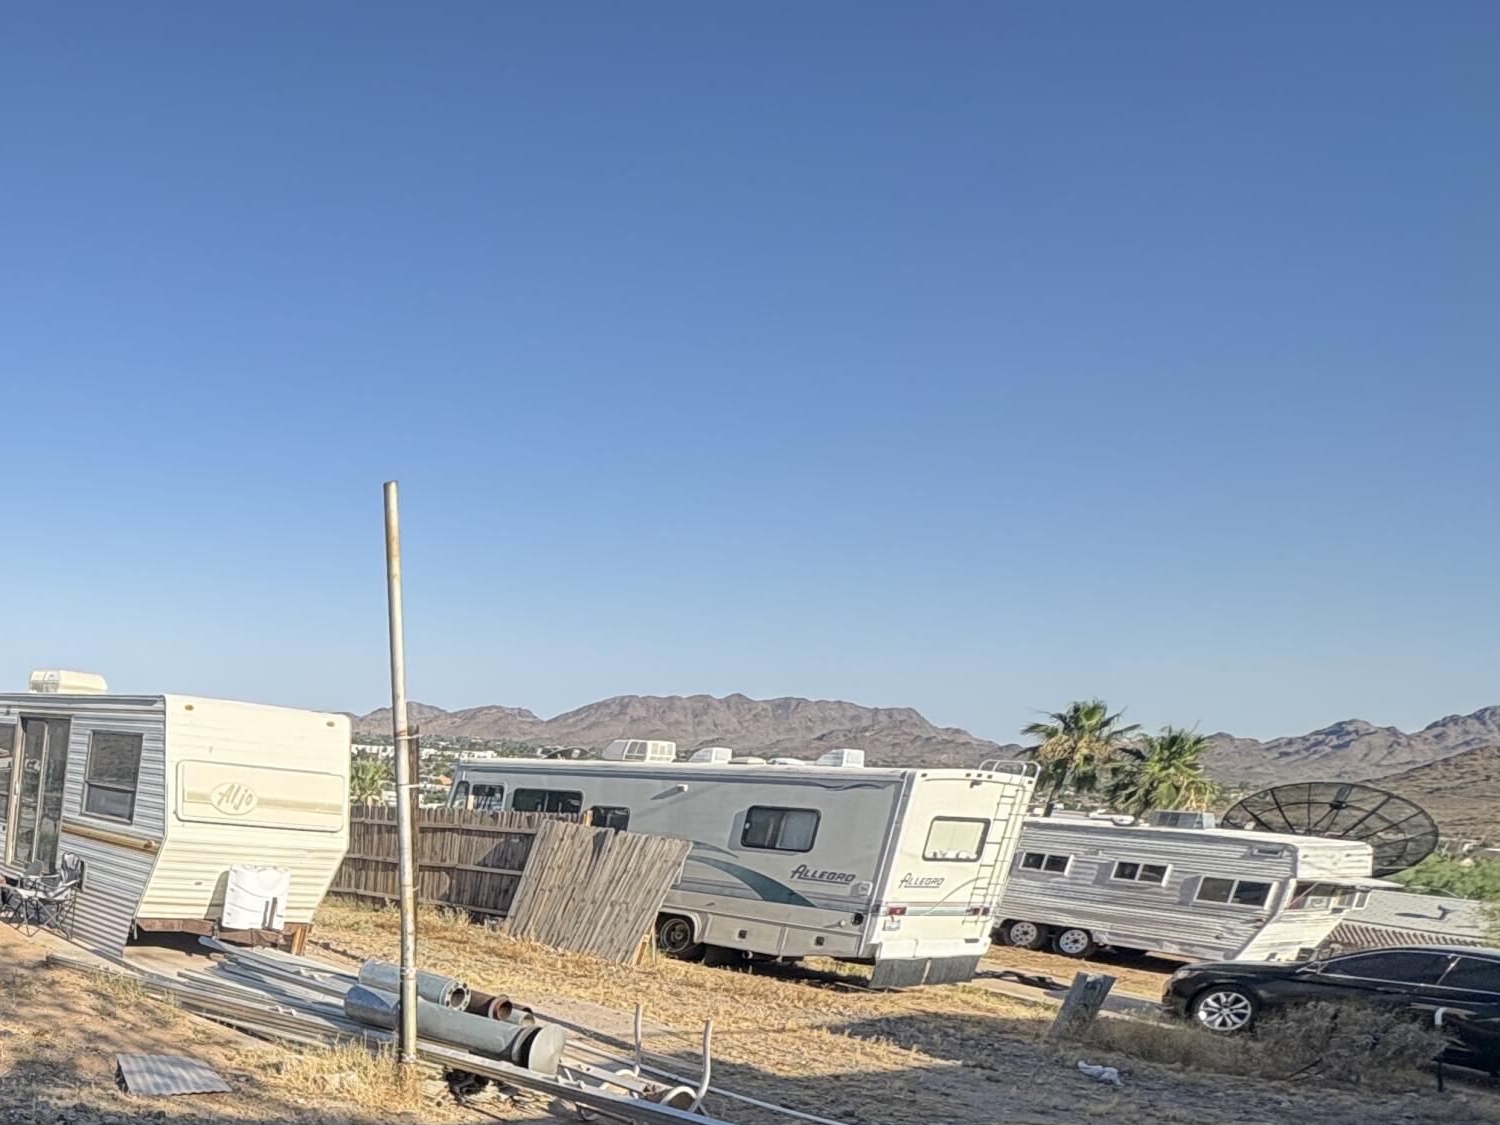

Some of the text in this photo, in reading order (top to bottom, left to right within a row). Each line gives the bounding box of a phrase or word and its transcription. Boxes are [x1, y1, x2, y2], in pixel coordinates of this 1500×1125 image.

[217, 783, 254, 811] Aljo
[790, 864, 857, 885] ALLEGRO
[898, 872, 946, 888] ALLEGRO
